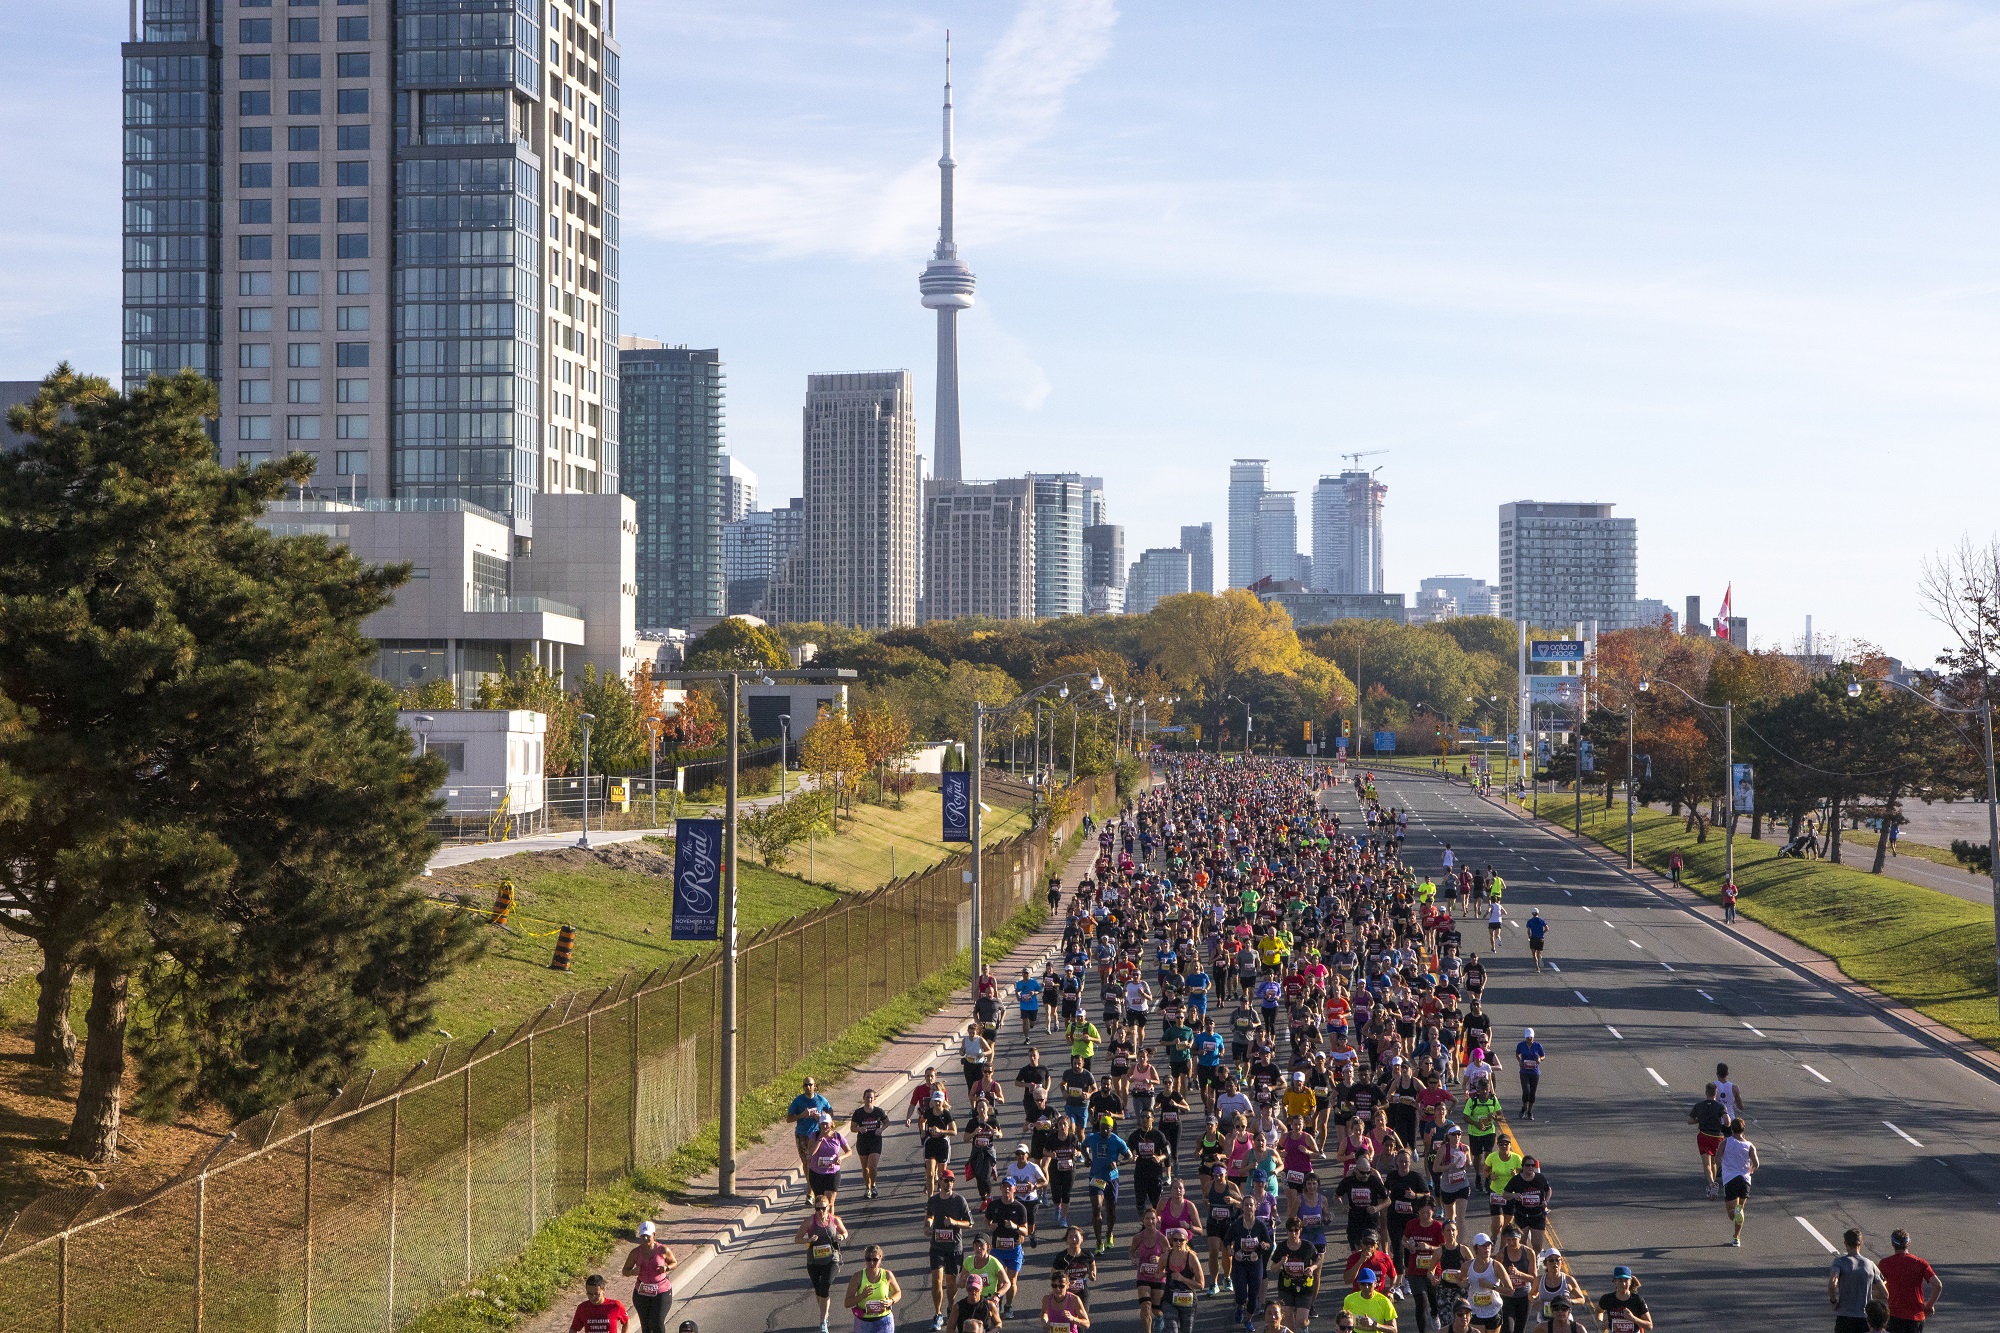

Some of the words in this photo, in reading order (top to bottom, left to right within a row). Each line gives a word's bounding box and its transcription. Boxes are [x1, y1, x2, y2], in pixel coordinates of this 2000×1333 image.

[1550, 643, 1577, 651] ontario
[1552, 649, 1575, 658] place
[613, 787, 624, 795] NO
[945, 776, 967, 828] Royal
[681, 840, 693, 862] The
[678, 826, 716, 914] Royal
